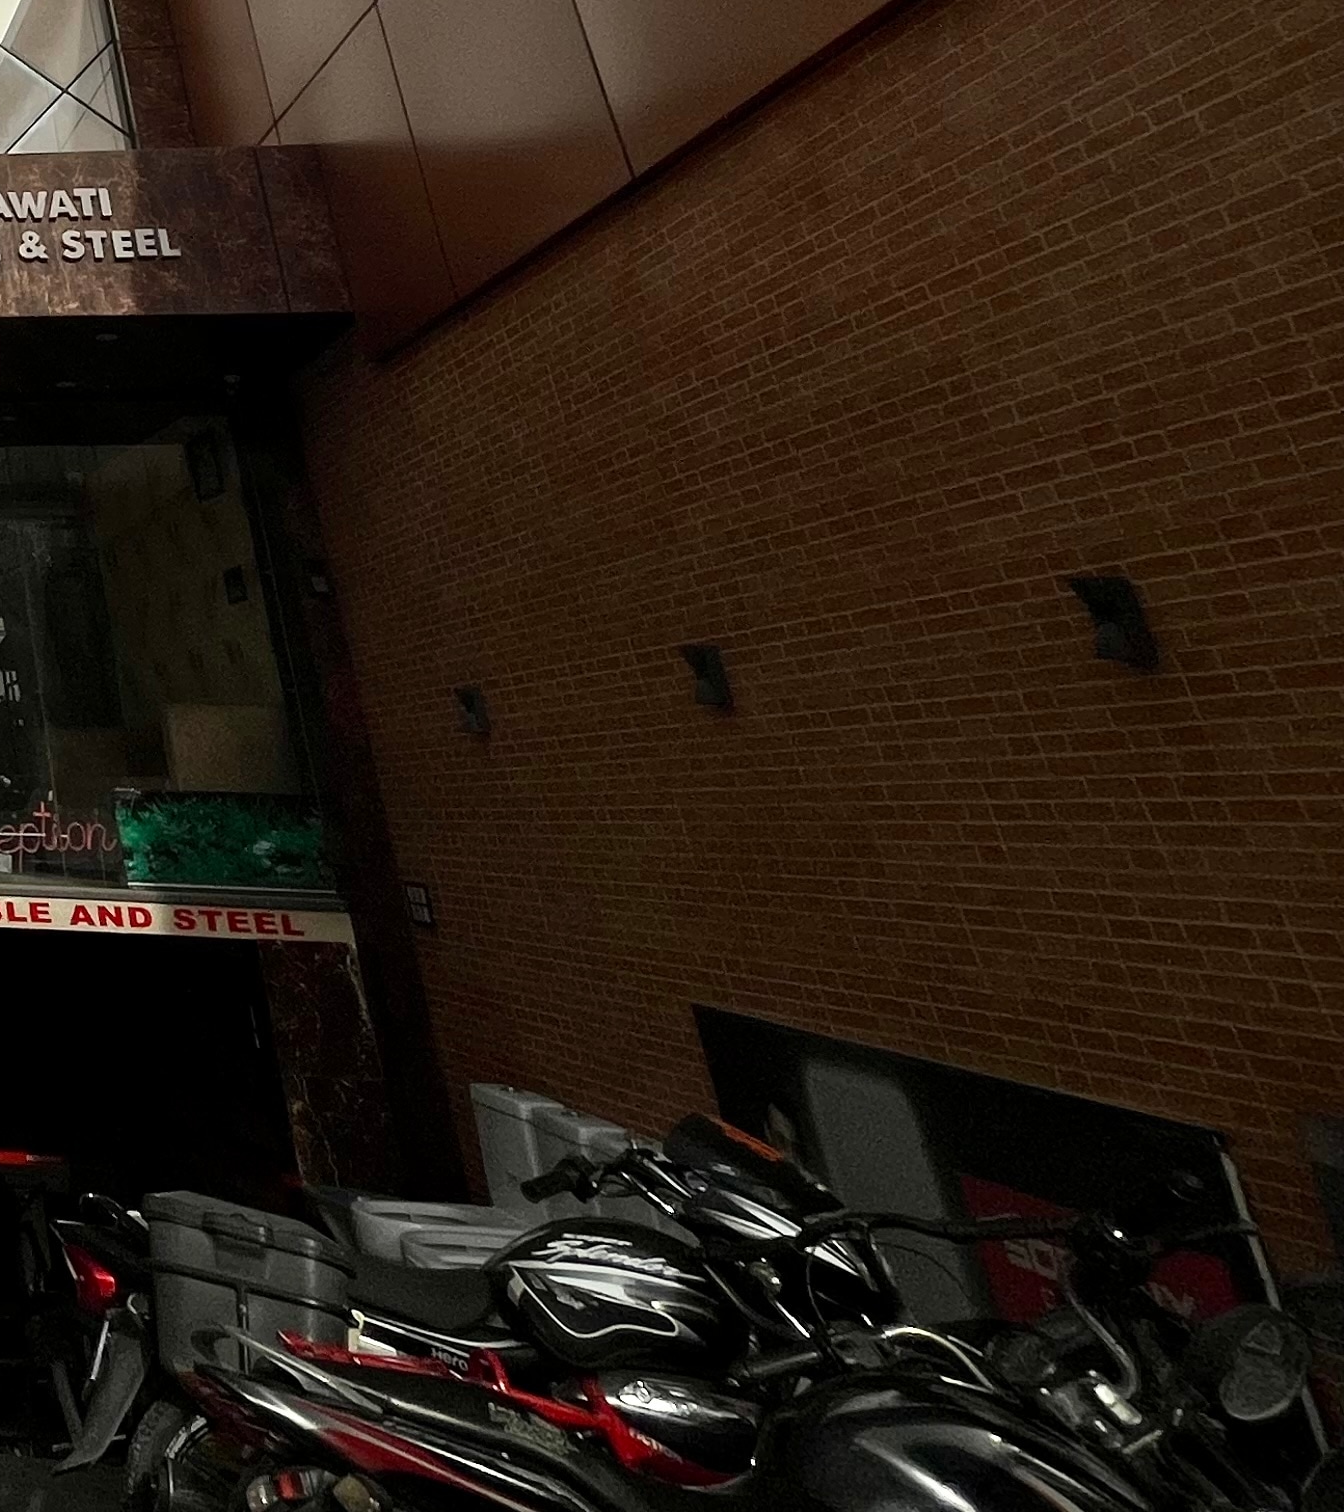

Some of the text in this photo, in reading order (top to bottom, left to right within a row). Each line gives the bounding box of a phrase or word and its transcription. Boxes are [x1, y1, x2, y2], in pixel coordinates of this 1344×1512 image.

[19, 230, 49, 260] &
[62, 228, 182, 260] STEEL
[69, 903, 153, 930] AND
[173, 908, 305, 937] STEEL
[430, 1346, 469, 1373] Hero
